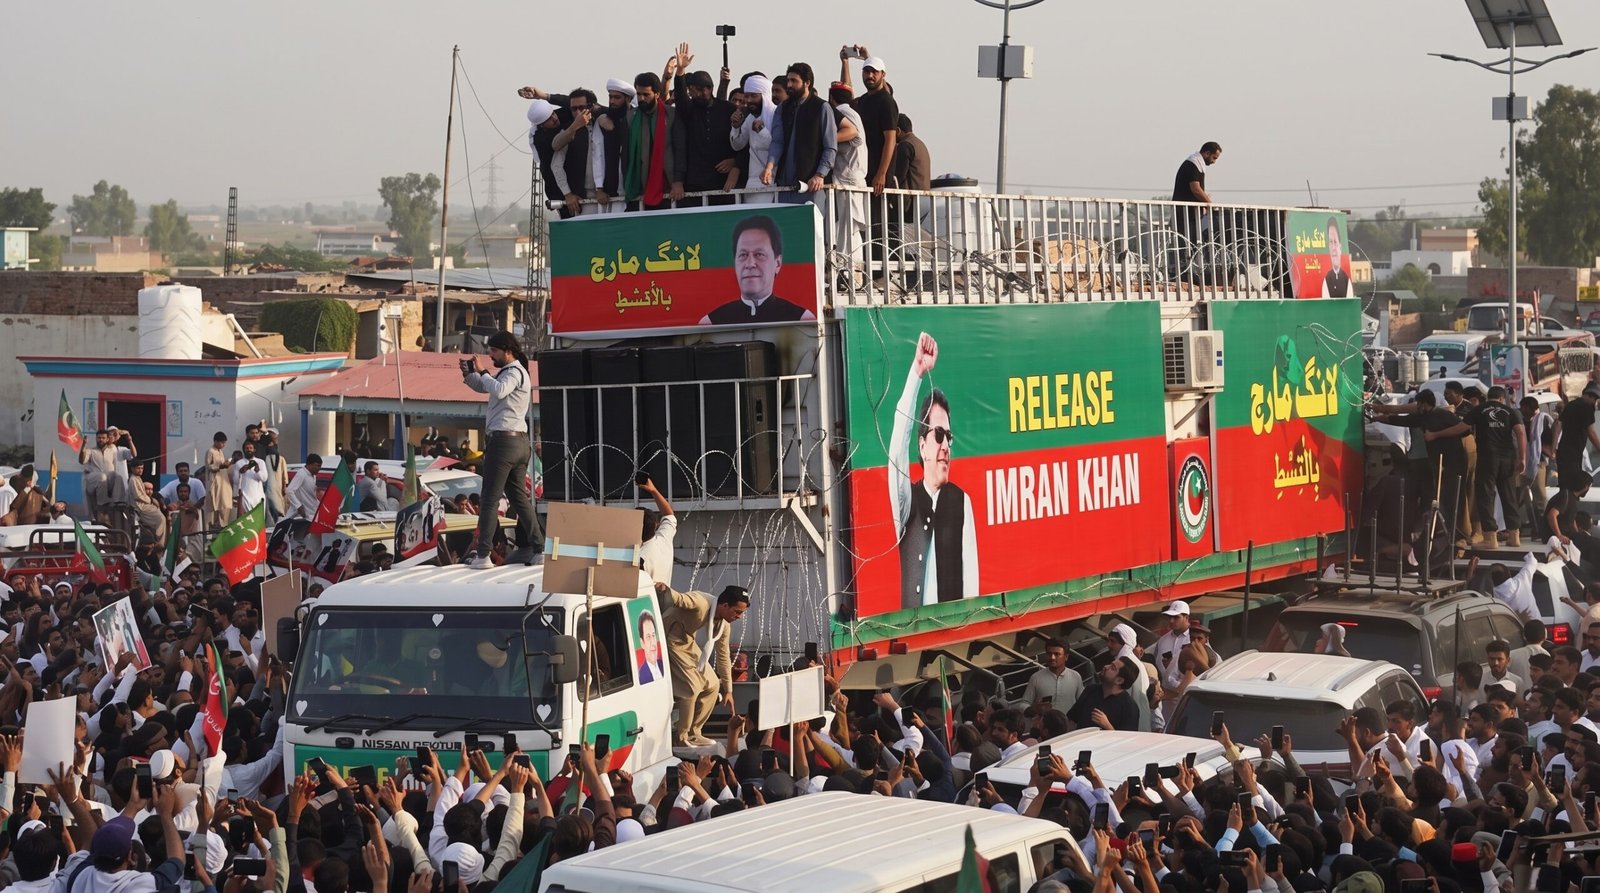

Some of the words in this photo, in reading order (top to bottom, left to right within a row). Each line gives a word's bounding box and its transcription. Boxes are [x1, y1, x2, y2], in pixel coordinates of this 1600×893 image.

[644, 239, 702, 273] لانگ
[1008, 370, 1115, 433] RELEASE
[1295, 355, 1339, 418] لانگ
[985, 461, 1070, 526] IMRAN
[1077, 452, 1141, 513] KHAN
[362, 739, 410, 749] NISSAN
